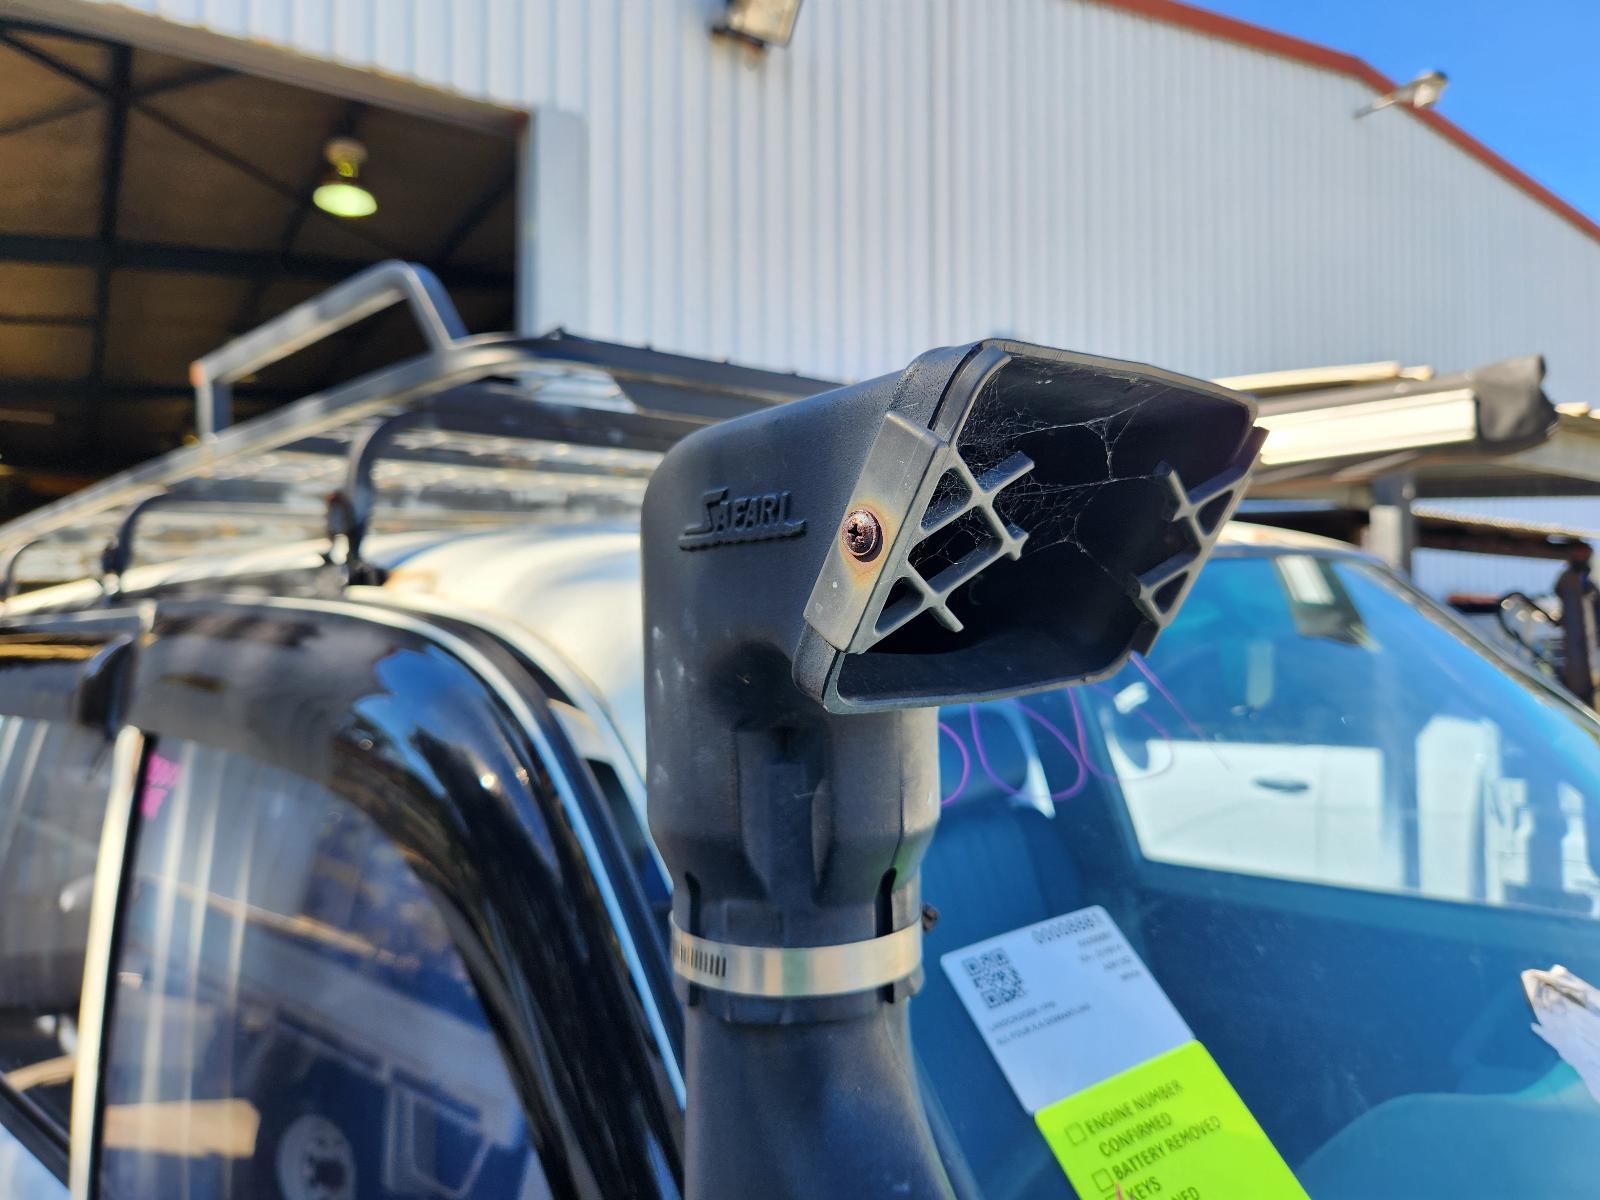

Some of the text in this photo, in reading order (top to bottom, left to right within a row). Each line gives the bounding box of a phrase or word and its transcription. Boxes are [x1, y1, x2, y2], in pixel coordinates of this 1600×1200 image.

[679, 486, 807, 550] SAFARI
[1084, 1079, 1184, 1136] ENGINE NUMBER
[1098, 1111, 1173, 1158] CONFIRMED
[1111, 1114, 1222, 1180] BATTERY REMOVED
[1125, 1175, 1162, 1200] KEYS
